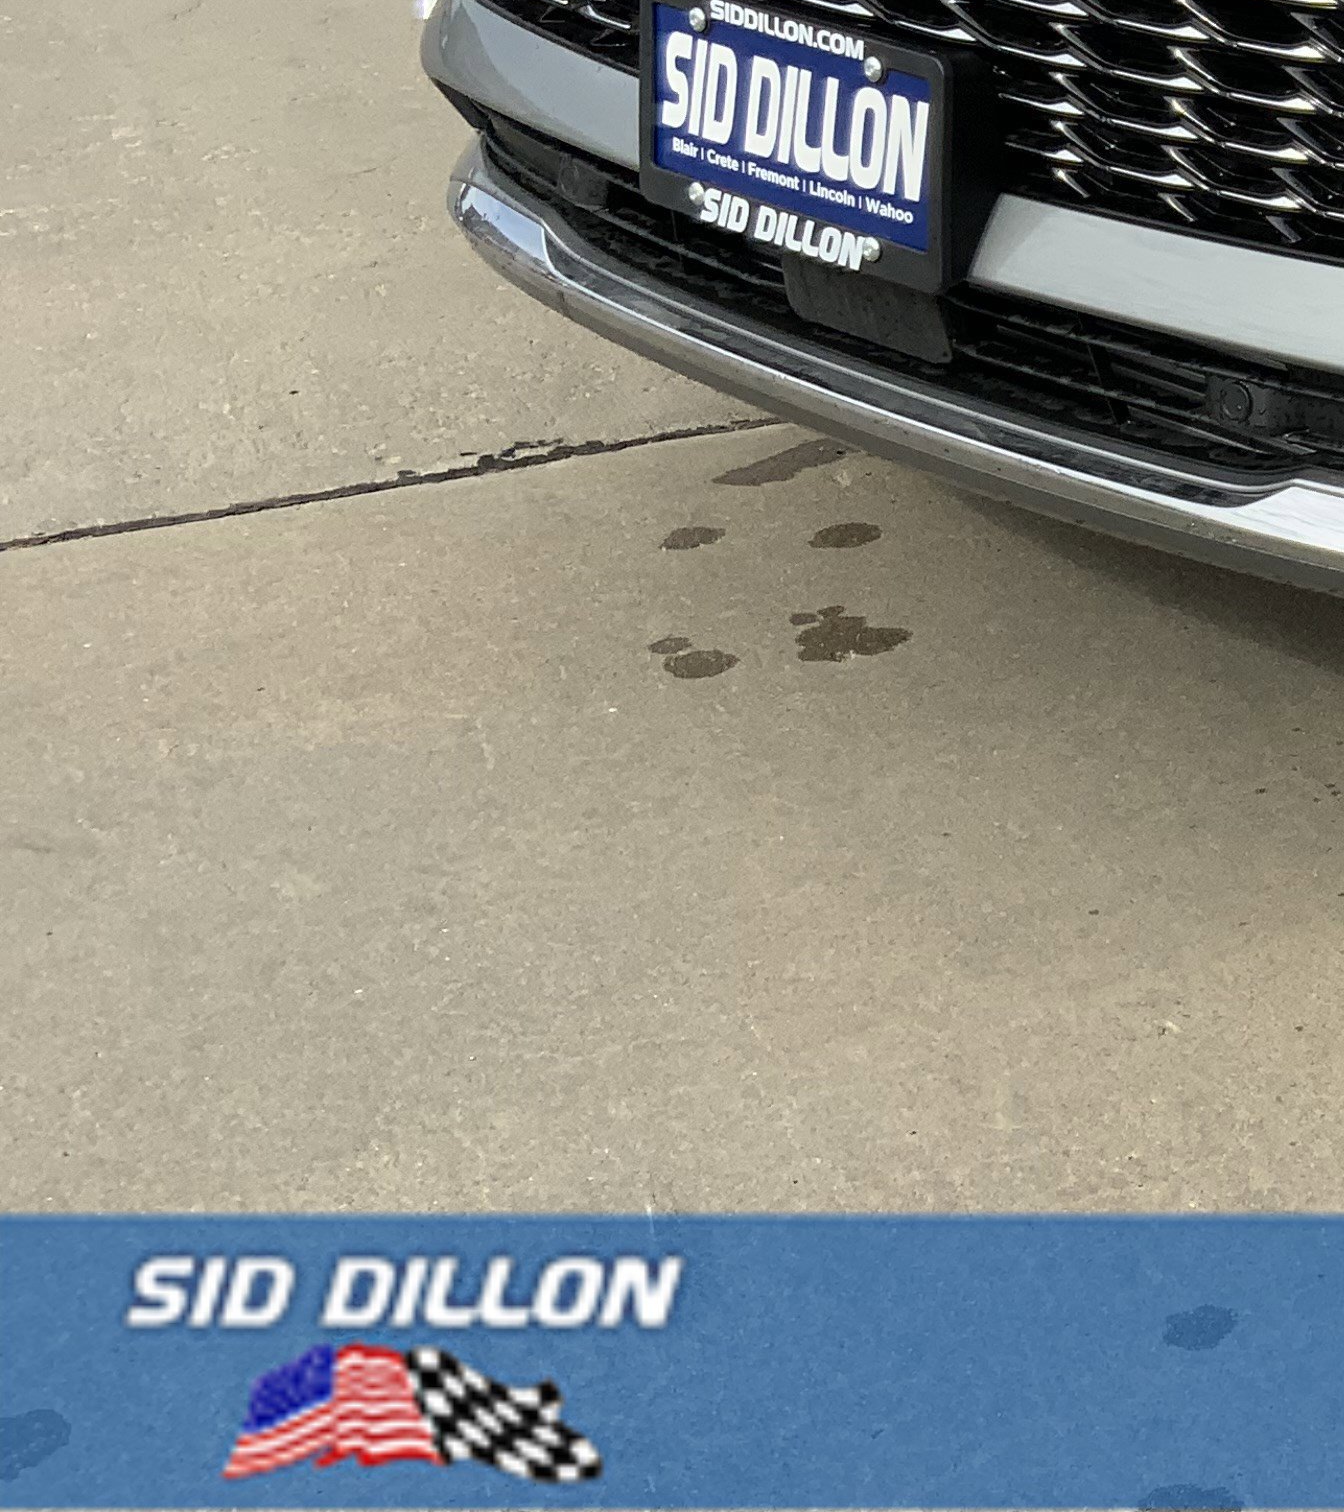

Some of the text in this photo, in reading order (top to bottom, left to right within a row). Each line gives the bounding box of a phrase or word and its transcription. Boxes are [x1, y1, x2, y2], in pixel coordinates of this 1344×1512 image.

[661, 31, 930, 202] SID DILLON
[672, 137, 914, 224] Blair Crete Fremont Lincoln Wahoo
[700, 188, 866, 271] SID DILLON
